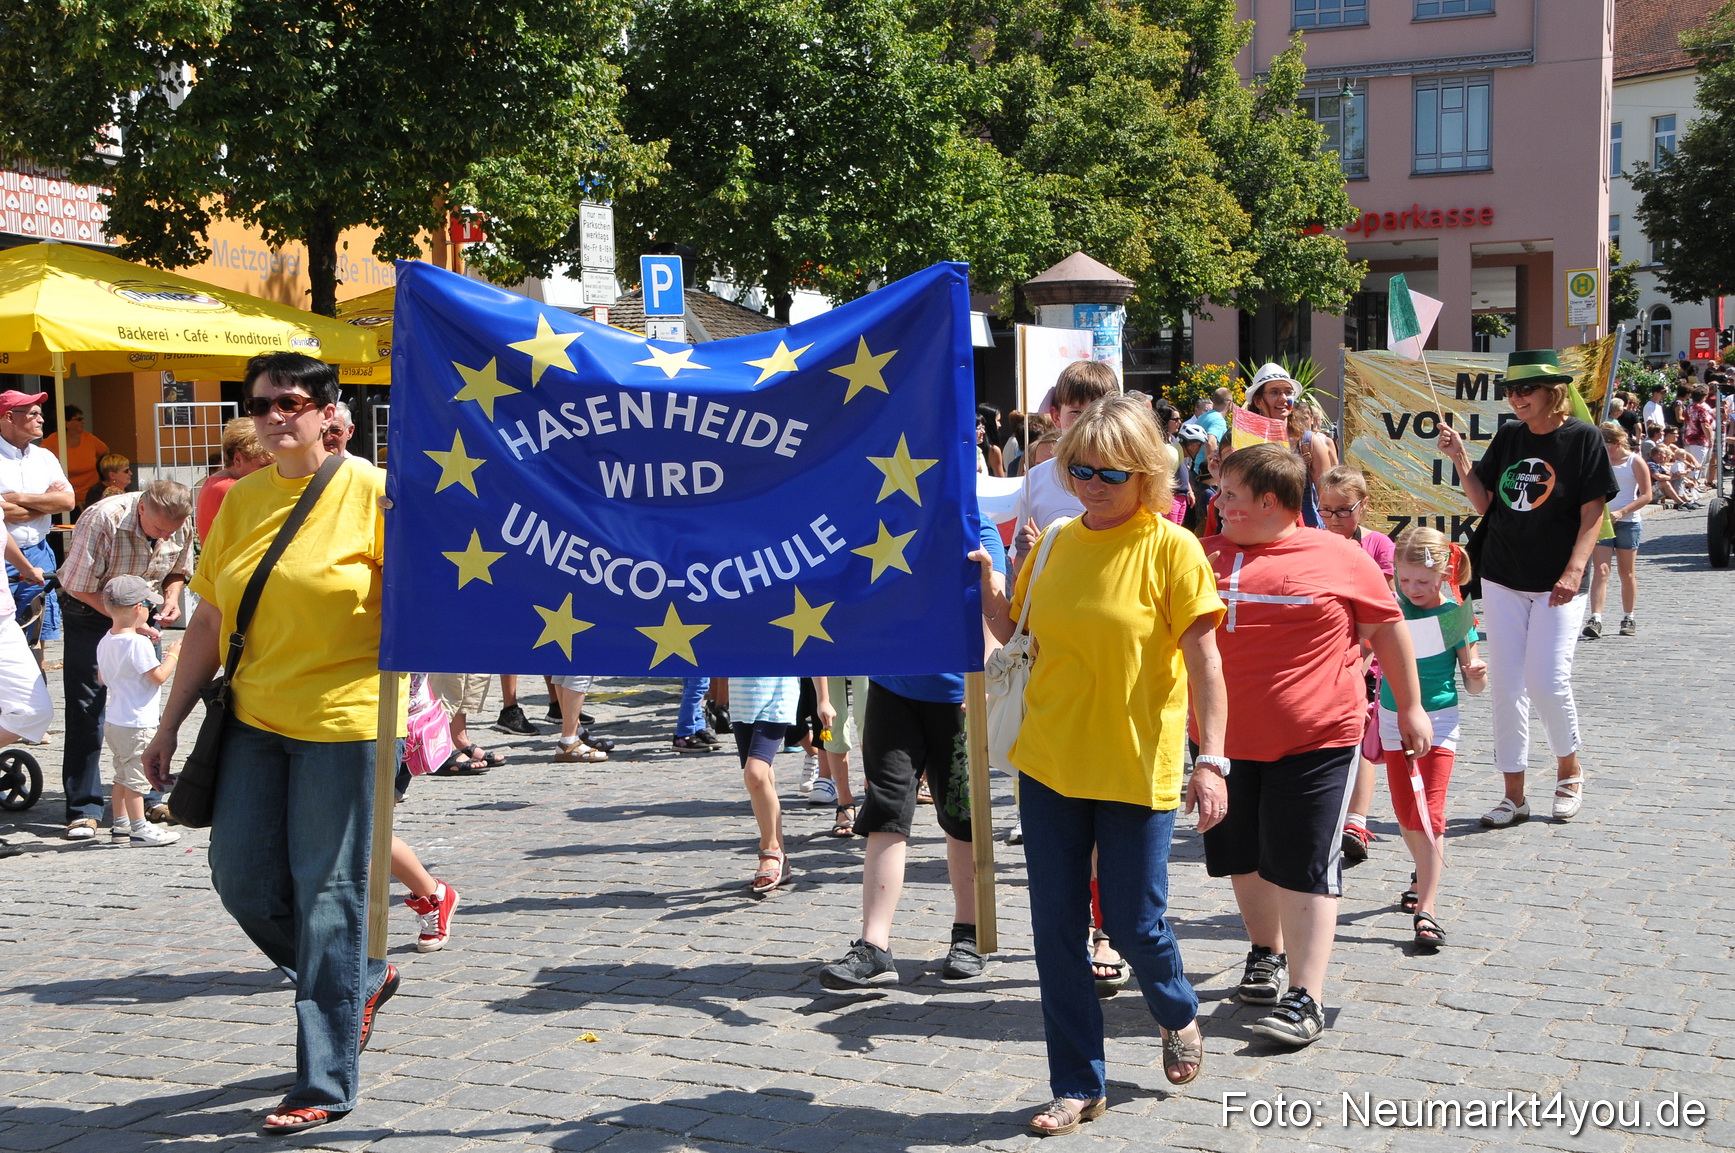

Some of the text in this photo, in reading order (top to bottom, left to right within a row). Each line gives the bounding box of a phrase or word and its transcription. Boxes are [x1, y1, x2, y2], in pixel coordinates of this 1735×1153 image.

[587, 211, 607, 220] nur mit
[583, 219, 611, 230] Parkschein
[586, 231, 609, 242] werktags
[212, 238, 301, 280] Metzgerei
[361, 257, 397, 286] Thek
[583, 253, 590, 262] Sa
[651, 263, 673, 308] P
[1576, 279, 1588, 292] H
[117, 325, 282, 346] Bäckerei Café Konditorei
[498, 391, 809, 461] HASENHEIDE
[1381, 410, 1518, 441] VOLL
[599, 460, 724, 498] WIRD
[1507, 471, 1542, 483] FLOGGING
[1503, 481, 1529, 491] MOLLY
[501, 502, 847, 602] UNESCO-SCHULE
